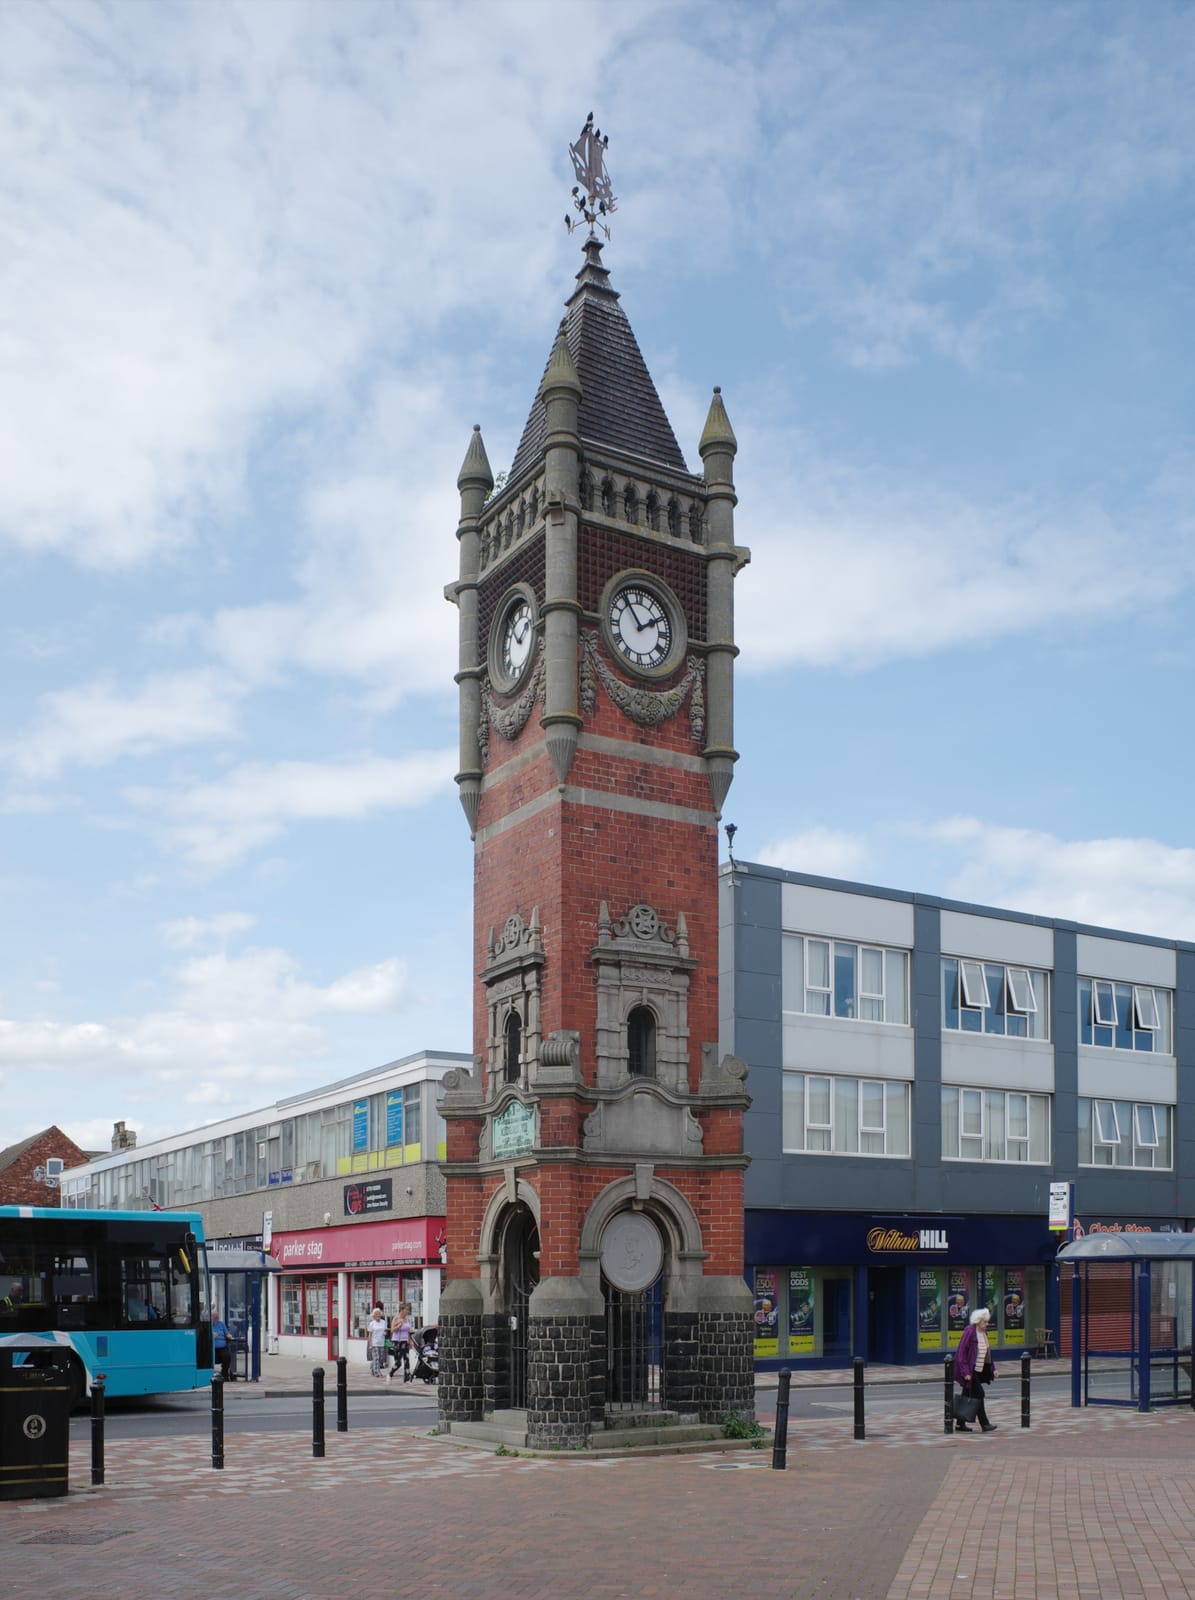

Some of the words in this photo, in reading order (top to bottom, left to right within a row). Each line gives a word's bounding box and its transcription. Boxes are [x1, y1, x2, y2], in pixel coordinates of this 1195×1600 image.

[867, 1227, 920, 1250] William
[920, 1230, 949, 1249] HILL
[283, 1240, 306, 1262] parker
[307, 1241, 323, 1260] stag
[790, 1278, 809, 1286] ODDS
[920, 1278, 937, 1286] ODDS
